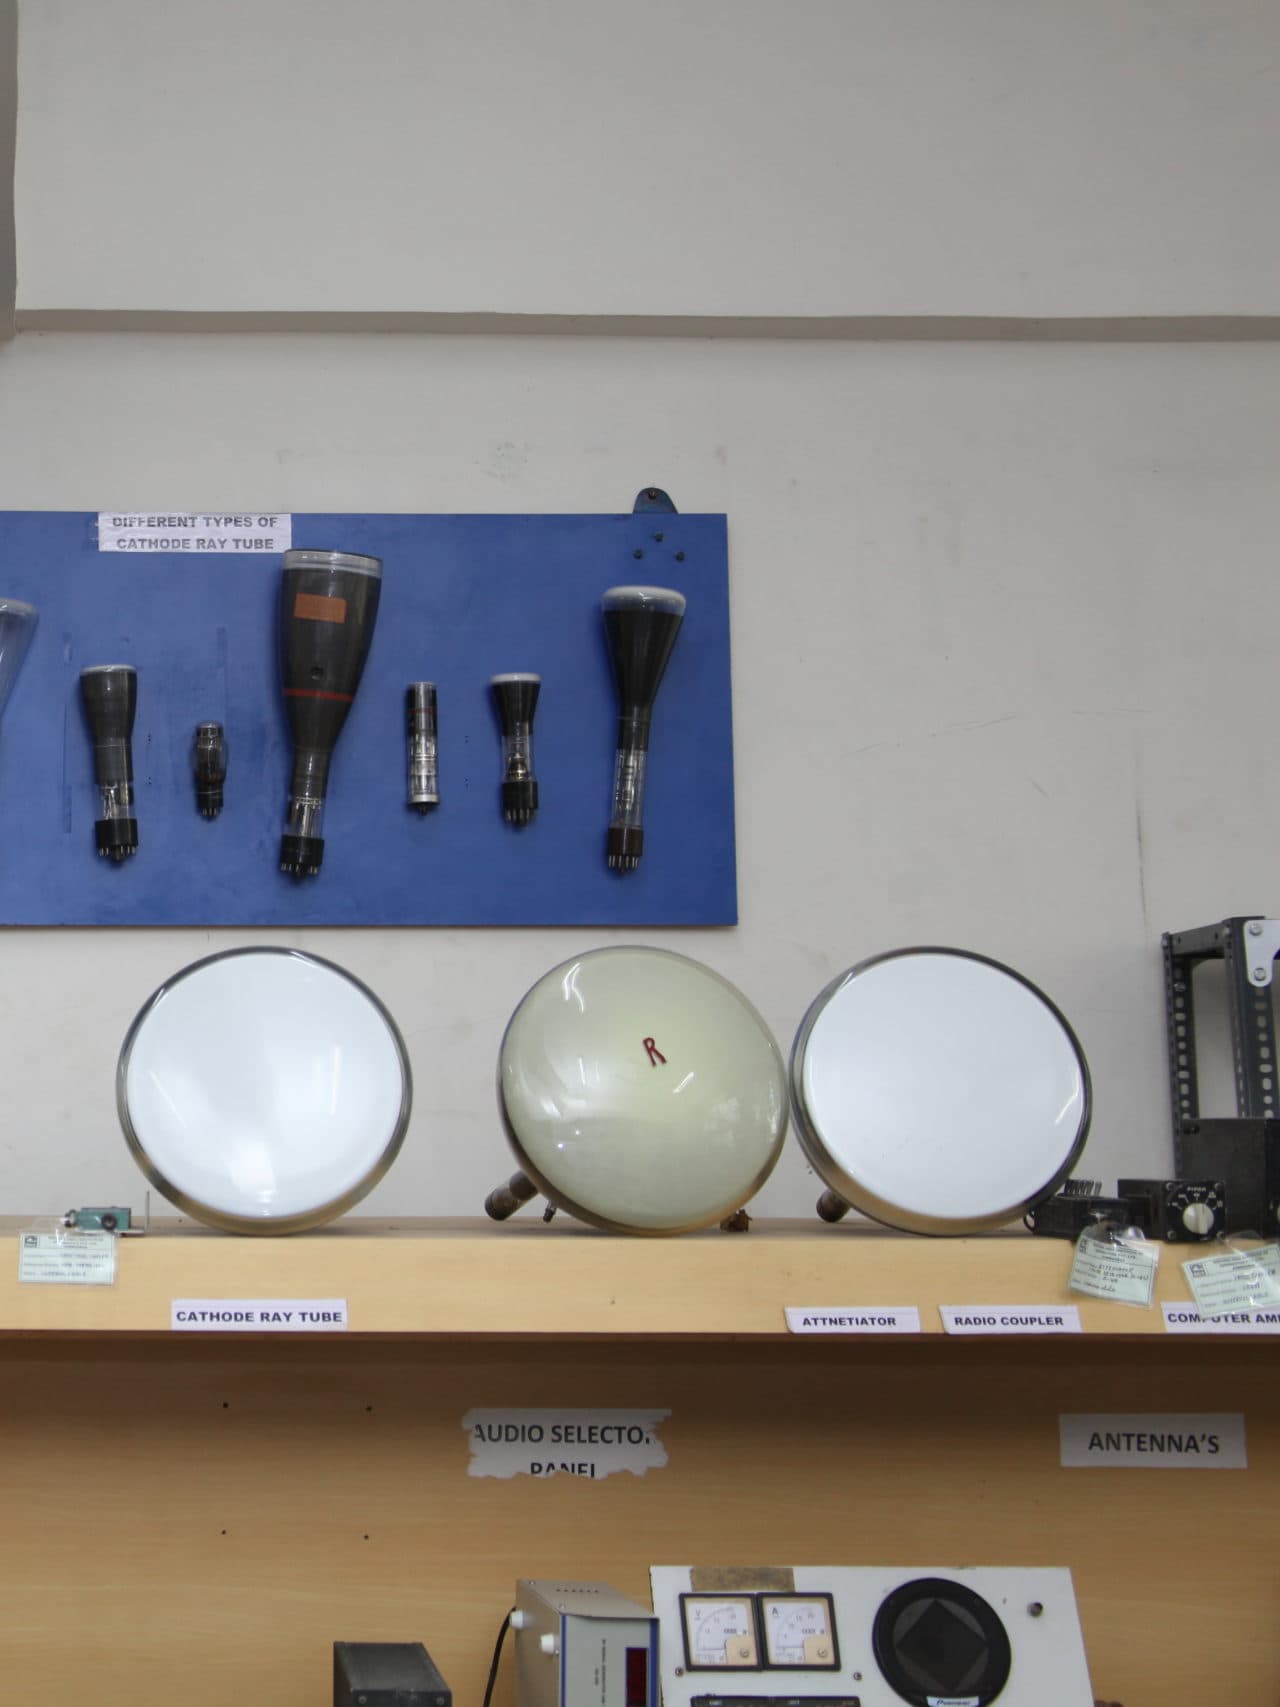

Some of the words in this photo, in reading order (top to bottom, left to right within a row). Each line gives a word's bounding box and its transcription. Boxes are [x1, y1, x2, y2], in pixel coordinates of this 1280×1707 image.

[112, 516, 198, 528] DIFFERENT
[203, 516, 253, 528] TYPES
[257, 516, 278, 528] OF
[116, 538, 190, 550] CATHODE
[196, 538, 228, 550] RAY
[232, 538, 274, 550] TUBE
[643, 1037, 667, 1067] R
[176, 1311, 255, 1322] CATHODE
[260, 1311, 293, 1322] RAY
[299, 1311, 342, 1323] TUBE
[802, 1316, 897, 1327] ATTNETIATOR
[954, 1316, 996, 1327] RADIO
[1000, 1316, 1064, 1326] COUPLER
[1167, 1313, 1251, 1323] COMUTER
[1255, 1313, 1280, 1323] AM
[474, 1424, 544, 1442] AUDIO
[551, 1425, 651, 1444] SELECTO
[1088, 1432, 1220, 1454] ANTENNA'S
